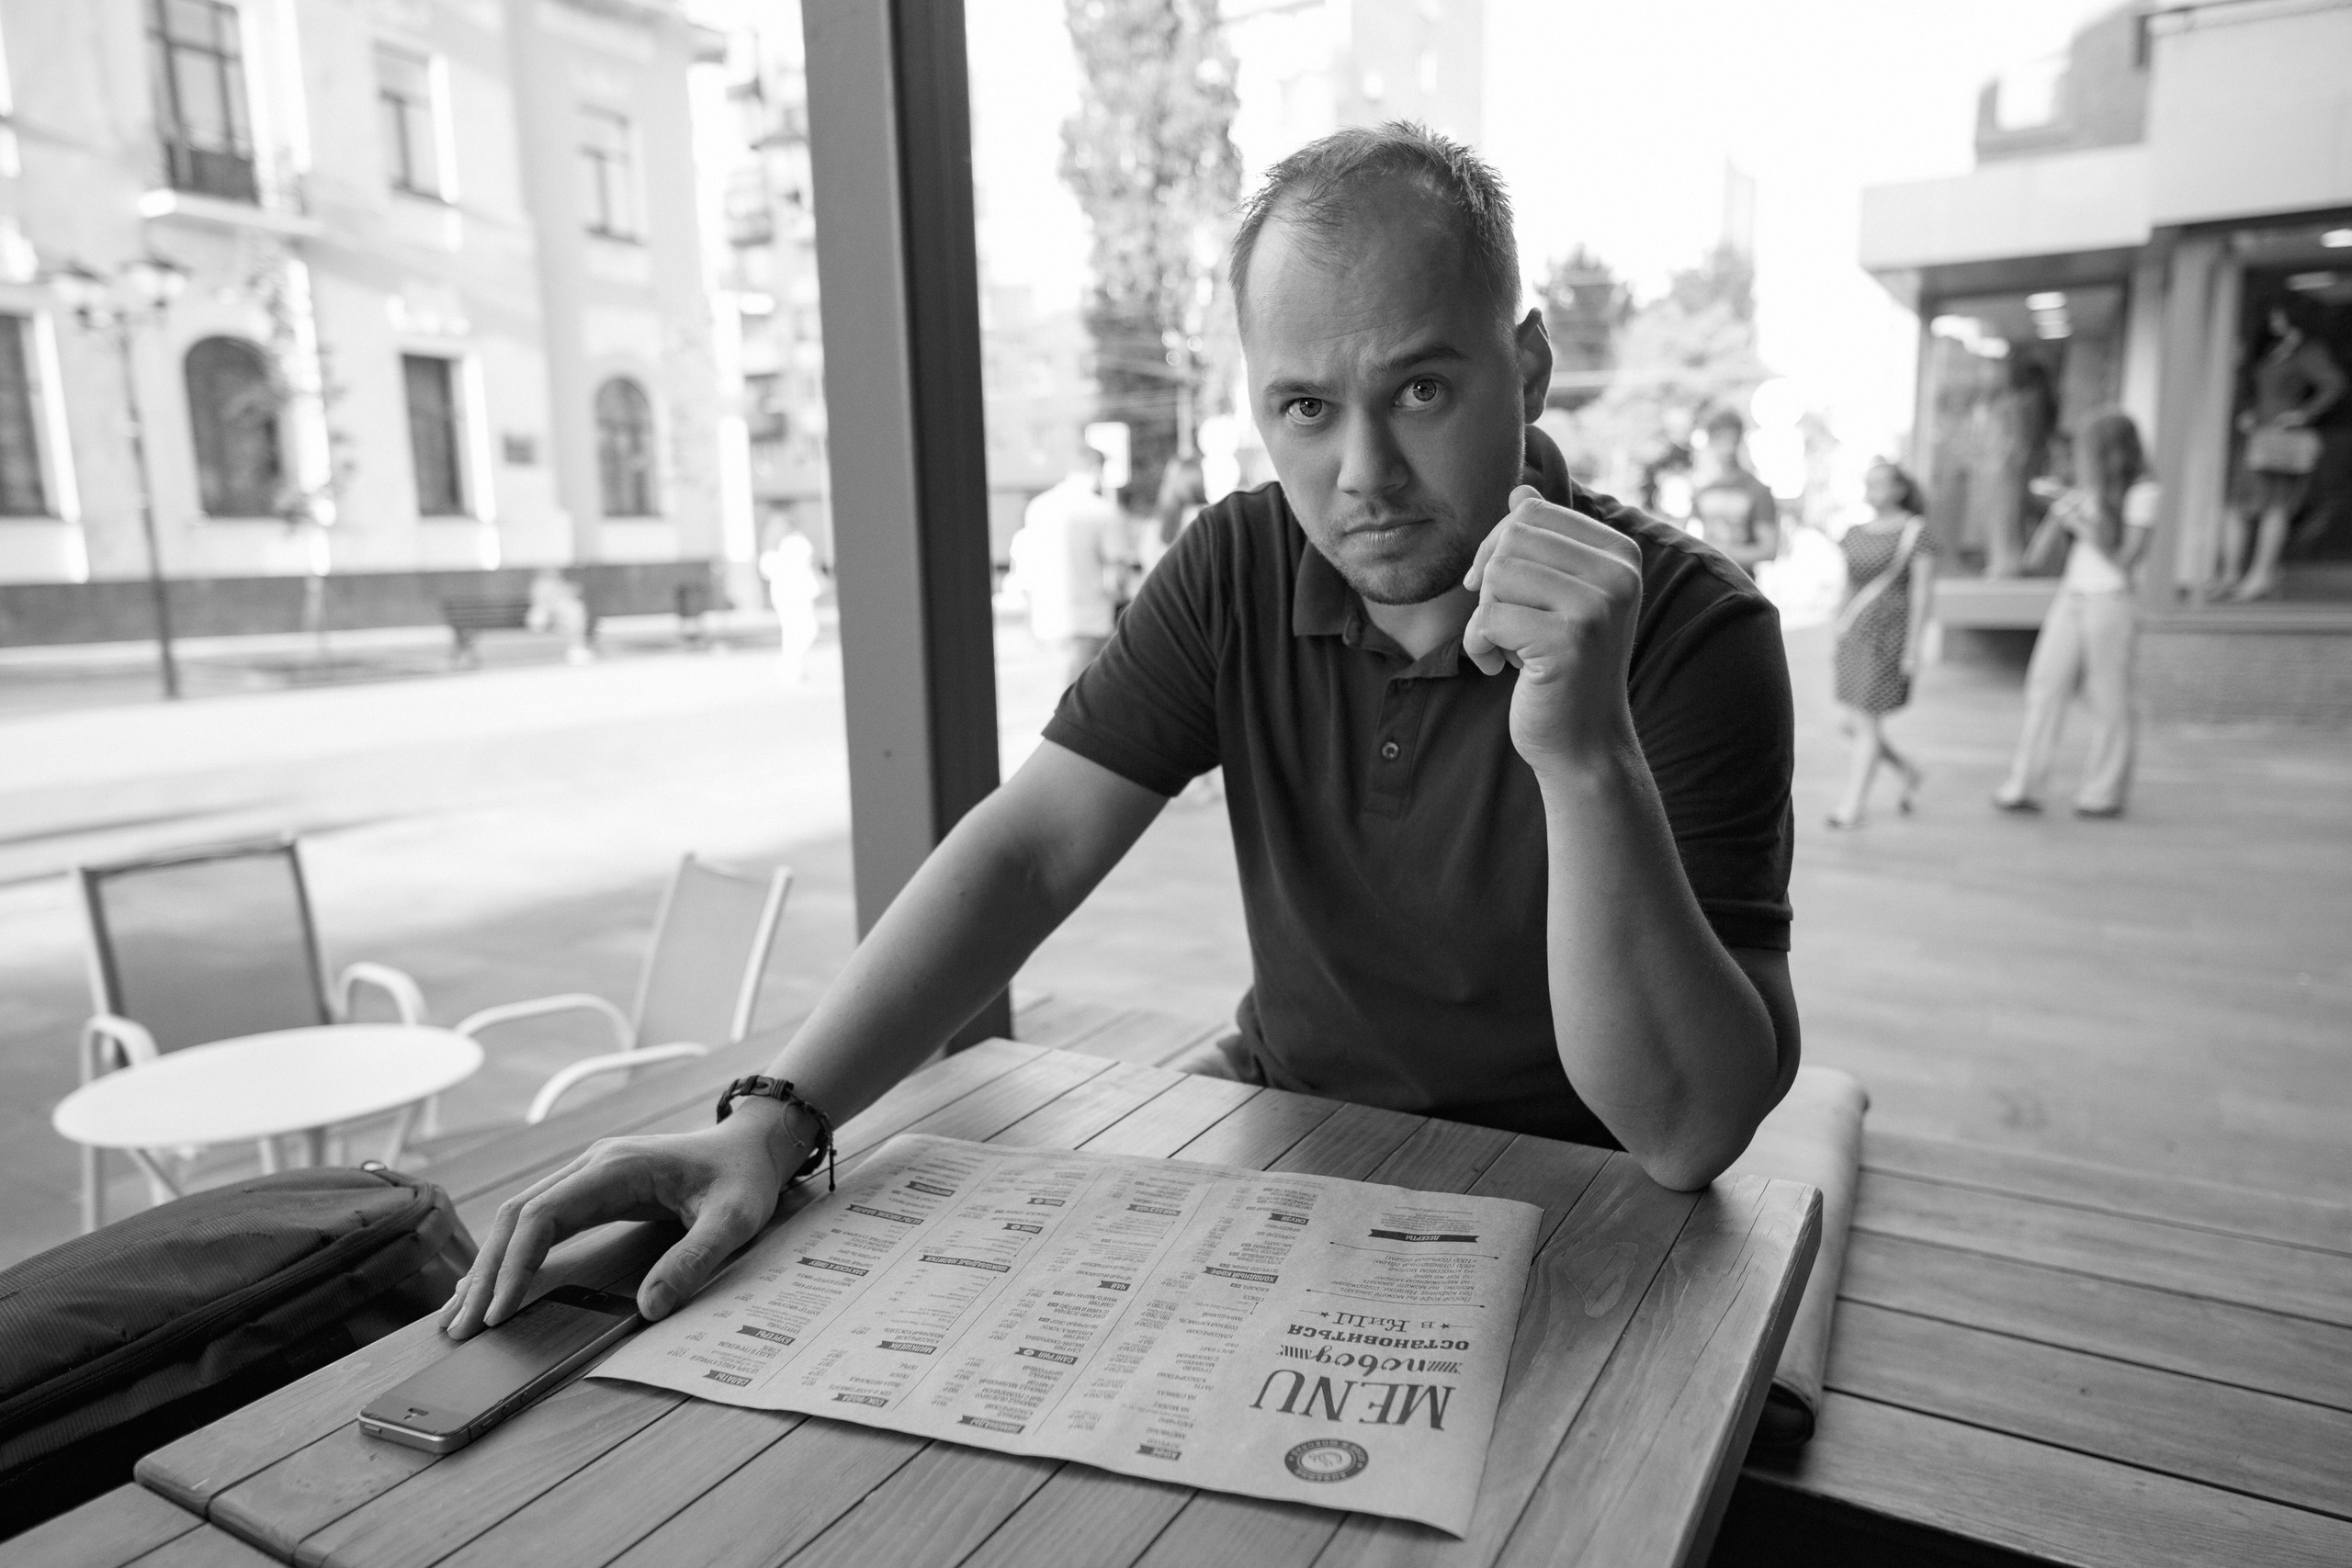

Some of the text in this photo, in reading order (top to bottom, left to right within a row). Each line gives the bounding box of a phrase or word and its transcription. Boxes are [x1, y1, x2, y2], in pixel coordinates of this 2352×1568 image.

[1281, 1215, 1306, 1224] СМУЗИ
[808, 1259, 828, 1269] ПИВУ
[925, 1255, 1008, 1271] ШОКОЛАДНЫЕ НАПИТКИ
[831, 1265, 866, 1276] ЗАКУСКИ
[1232, 1272, 1274, 1281] ХОЛОДНЫЙ
[1330, 1280, 1380, 1291] содержащие
[1340, 1287, 1373, 1295] заказать
[797, 1307, 821, 1315] БУРГЕР
[1332, 1312, 1433, 1332] в КиШ
[778, 1325, 801, 1334] БУРГЕР
[1185, 1328, 1233, 1338] КЛАССИЧЕСКИЙ
[755, 1330, 792, 1344] БУРГЕРЫ
[1287, 1324, 1469, 1351] остановиться
[888, 1340, 933, 1353] МИЛКШЕЙК
[754, 1350, 778, 1359] САЛАТ
[1037, 1352, 1074, 1362] САНГРИЯ
[1313, 1346, 1426, 1377] повод
[715, 1373, 749, 1385] САЛАТЫ
[842, 1393, 884, 1405] СОК/ВОДА
[1250, 1370, 1456, 1431] MENU
